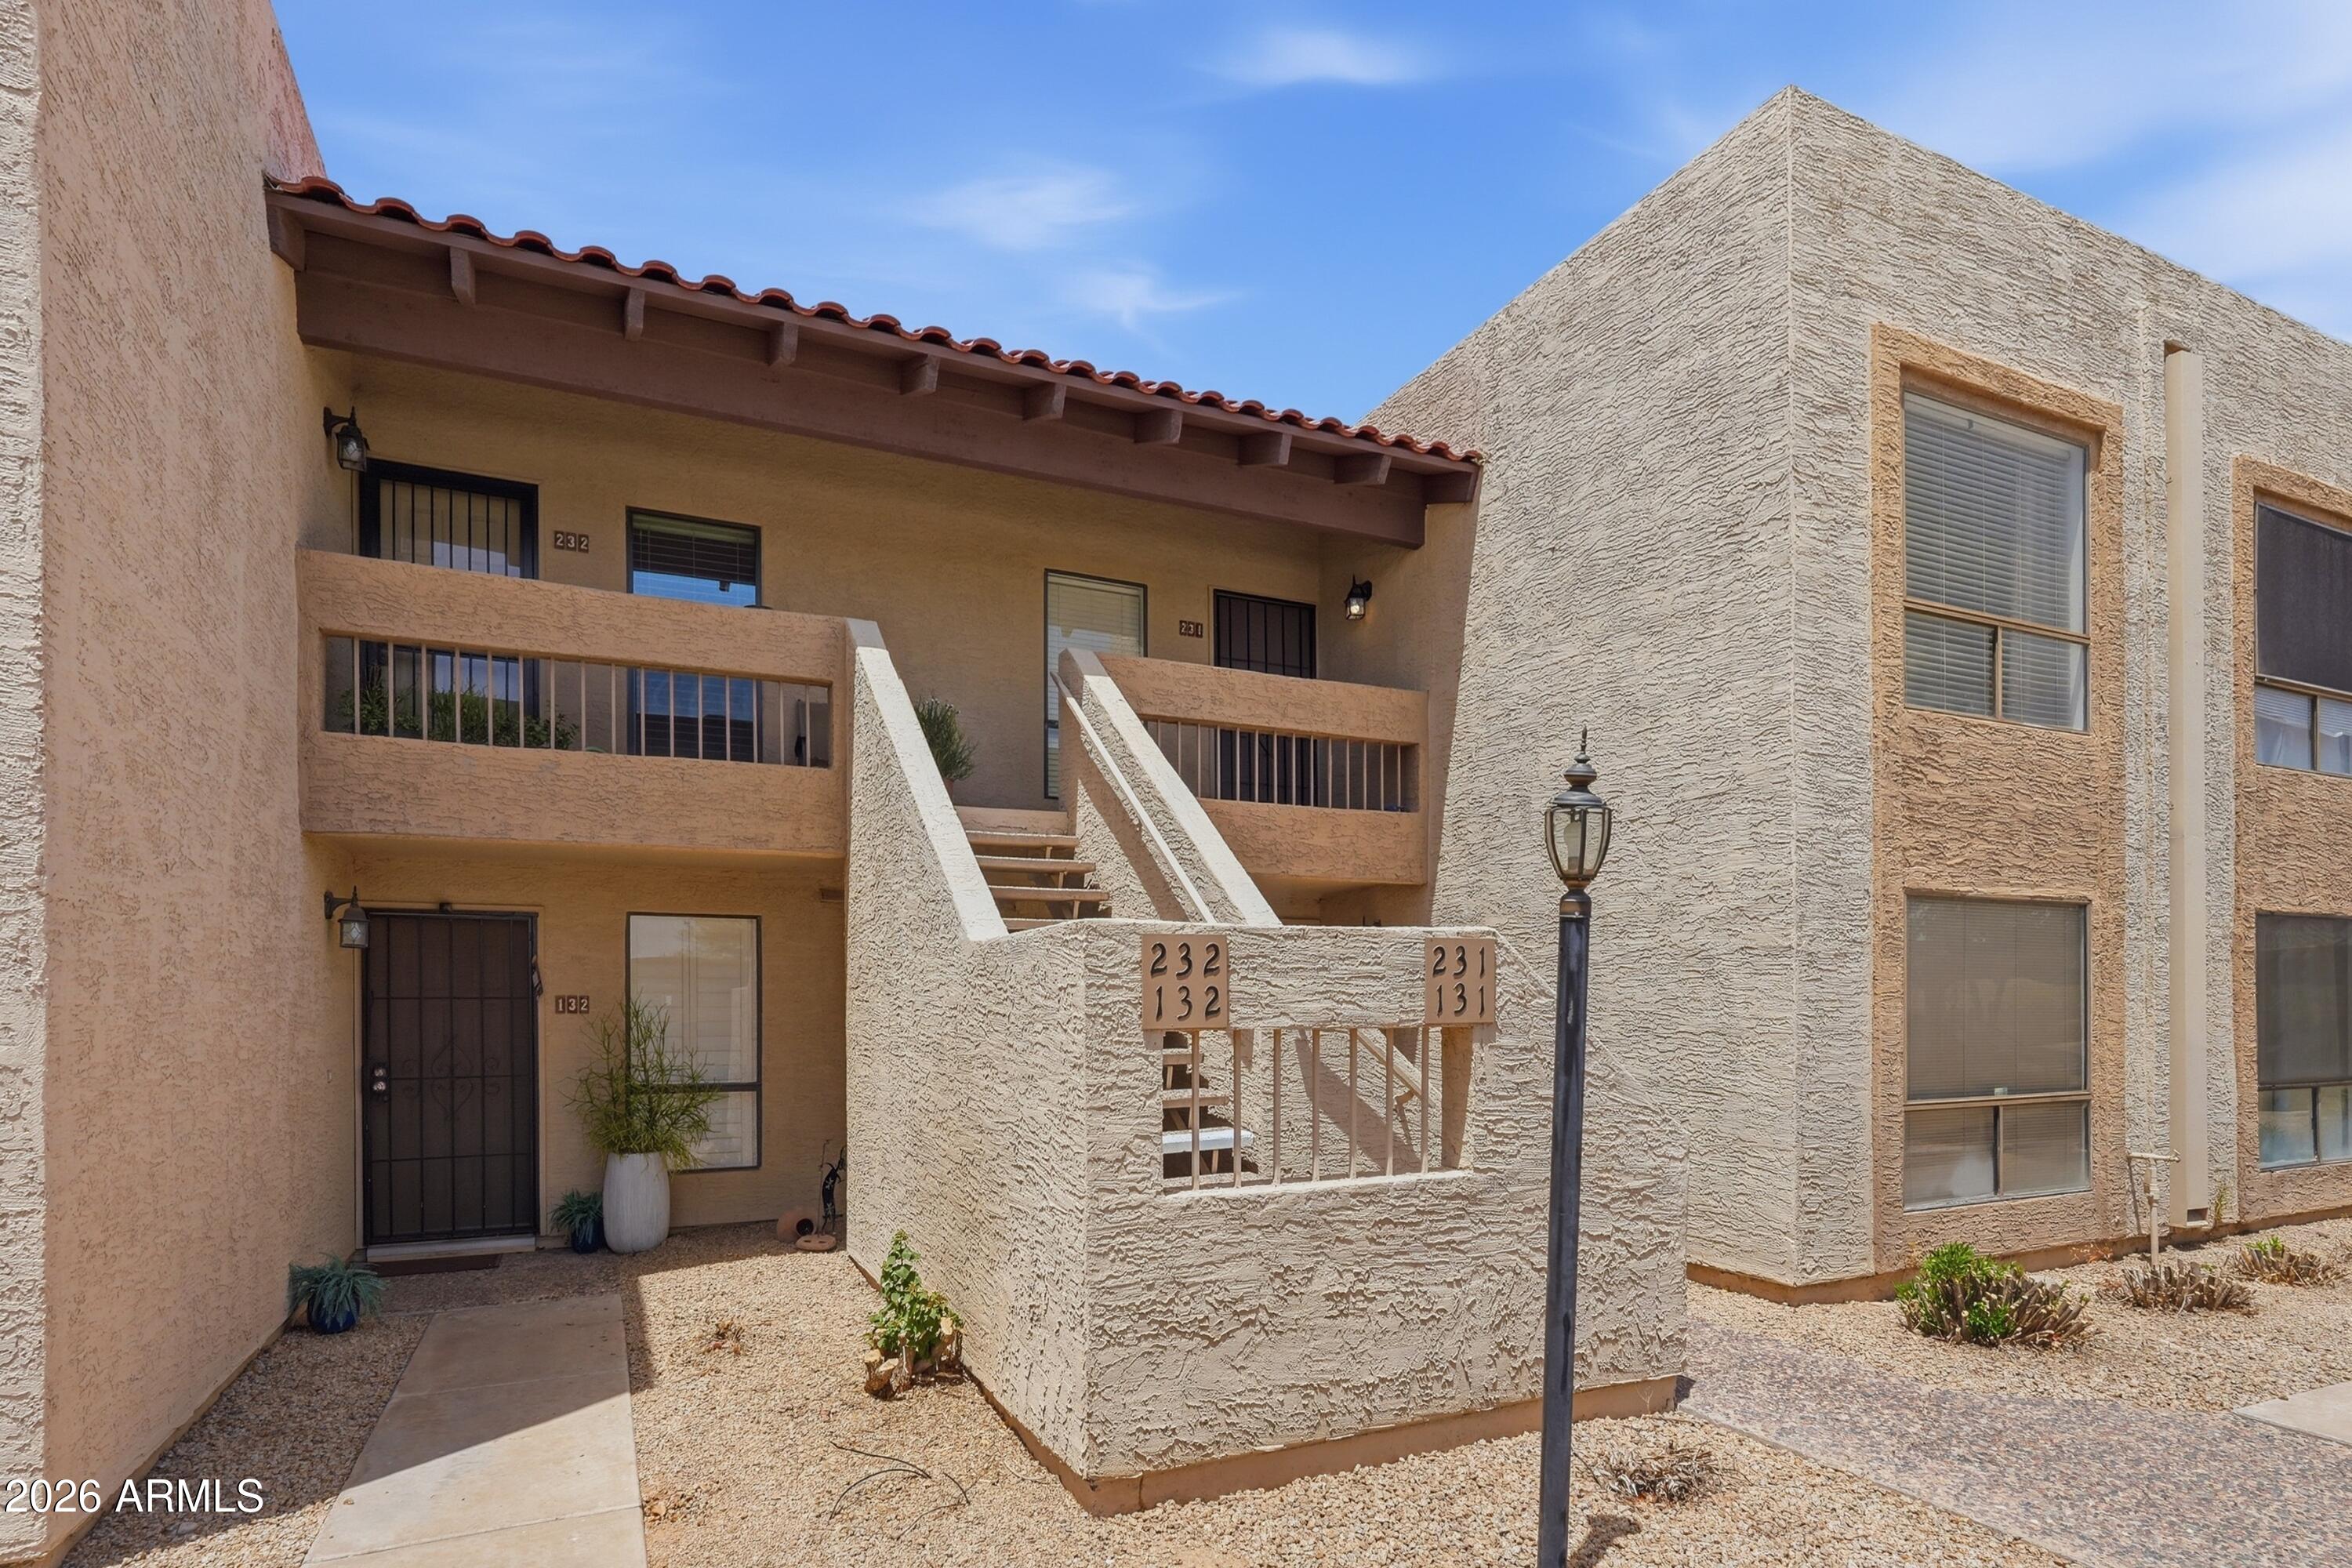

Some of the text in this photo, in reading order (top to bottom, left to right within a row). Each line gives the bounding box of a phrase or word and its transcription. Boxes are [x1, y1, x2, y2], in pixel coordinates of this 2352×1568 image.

[557, 533, 588, 550] 232
[1181, 622, 1201, 635] 231
[1151, 942, 1220, 979] 232
[1432, 945, 1485, 979] 231
[558, 998, 588, 1011] 132
[1156, 985, 1221, 1022] 132
[1436, 982, 1484, 1018] 131
